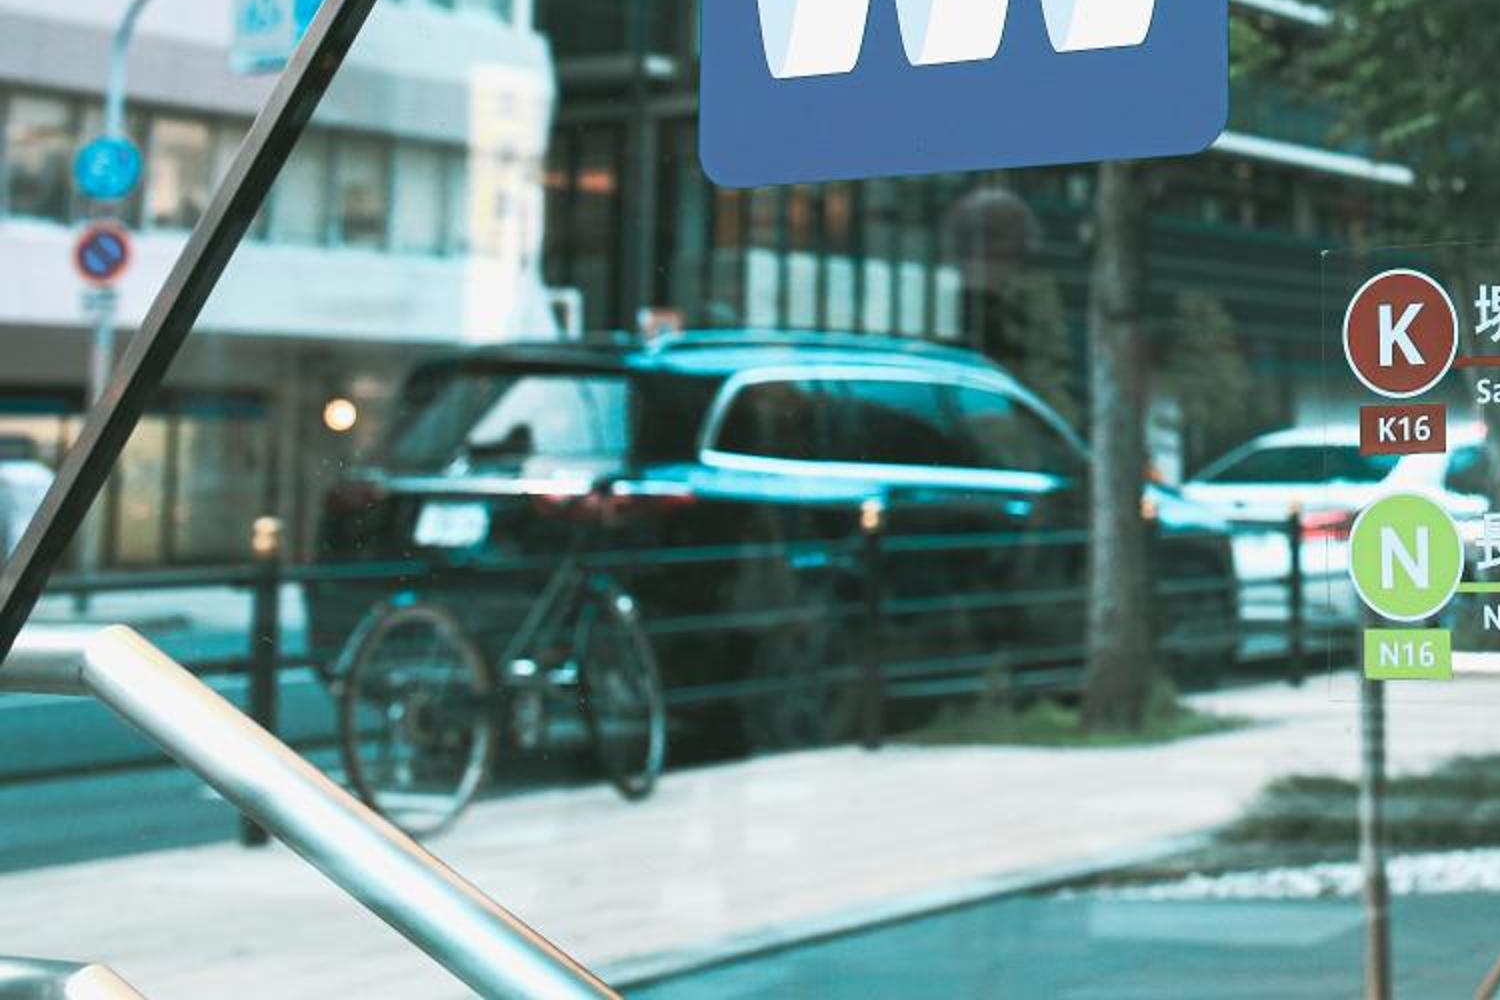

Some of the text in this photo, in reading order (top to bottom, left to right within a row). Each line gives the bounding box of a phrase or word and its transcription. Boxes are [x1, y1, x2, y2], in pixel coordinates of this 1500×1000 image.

[1378, 302, 1426, 367] K
[1378, 415, 1432, 443] K16
[1380, 525, 1431, 590] N
[1378, 640, 1436, 669] N16
